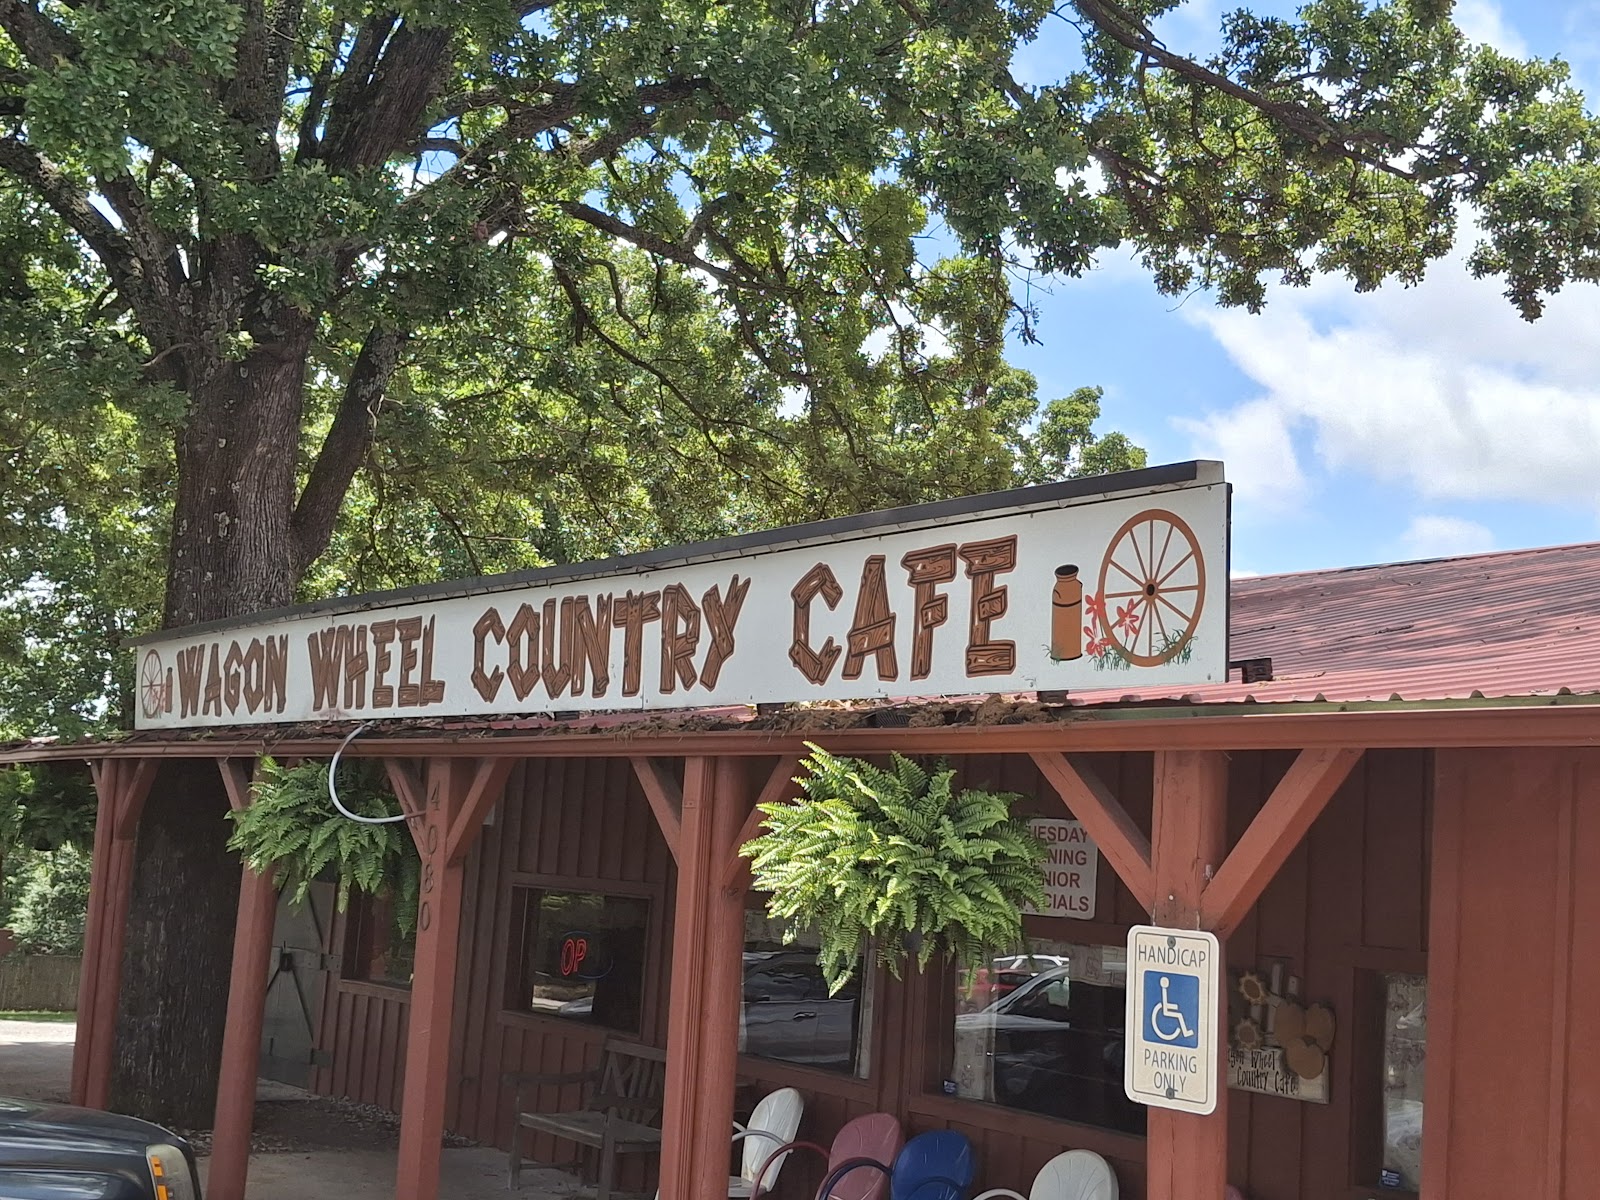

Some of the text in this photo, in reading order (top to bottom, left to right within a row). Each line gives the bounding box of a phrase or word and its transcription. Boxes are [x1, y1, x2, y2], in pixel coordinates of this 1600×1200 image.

[176, 534, 1018, 719] WAGON WHEEL COUNTRY CAFE
[1032, 825, 1088, 843] ESDAY
[1047, 848, 1087, 865] NING
[1041, 871, 1081, 889] NIOR
[1026, 893, 1090, 912] CIALS
[1138, 944, 1206, 968] HANDICAP
[1144, 1048, 1197, 1074] PARKING
[1153, 1071, 1187, 1093] ONLY
